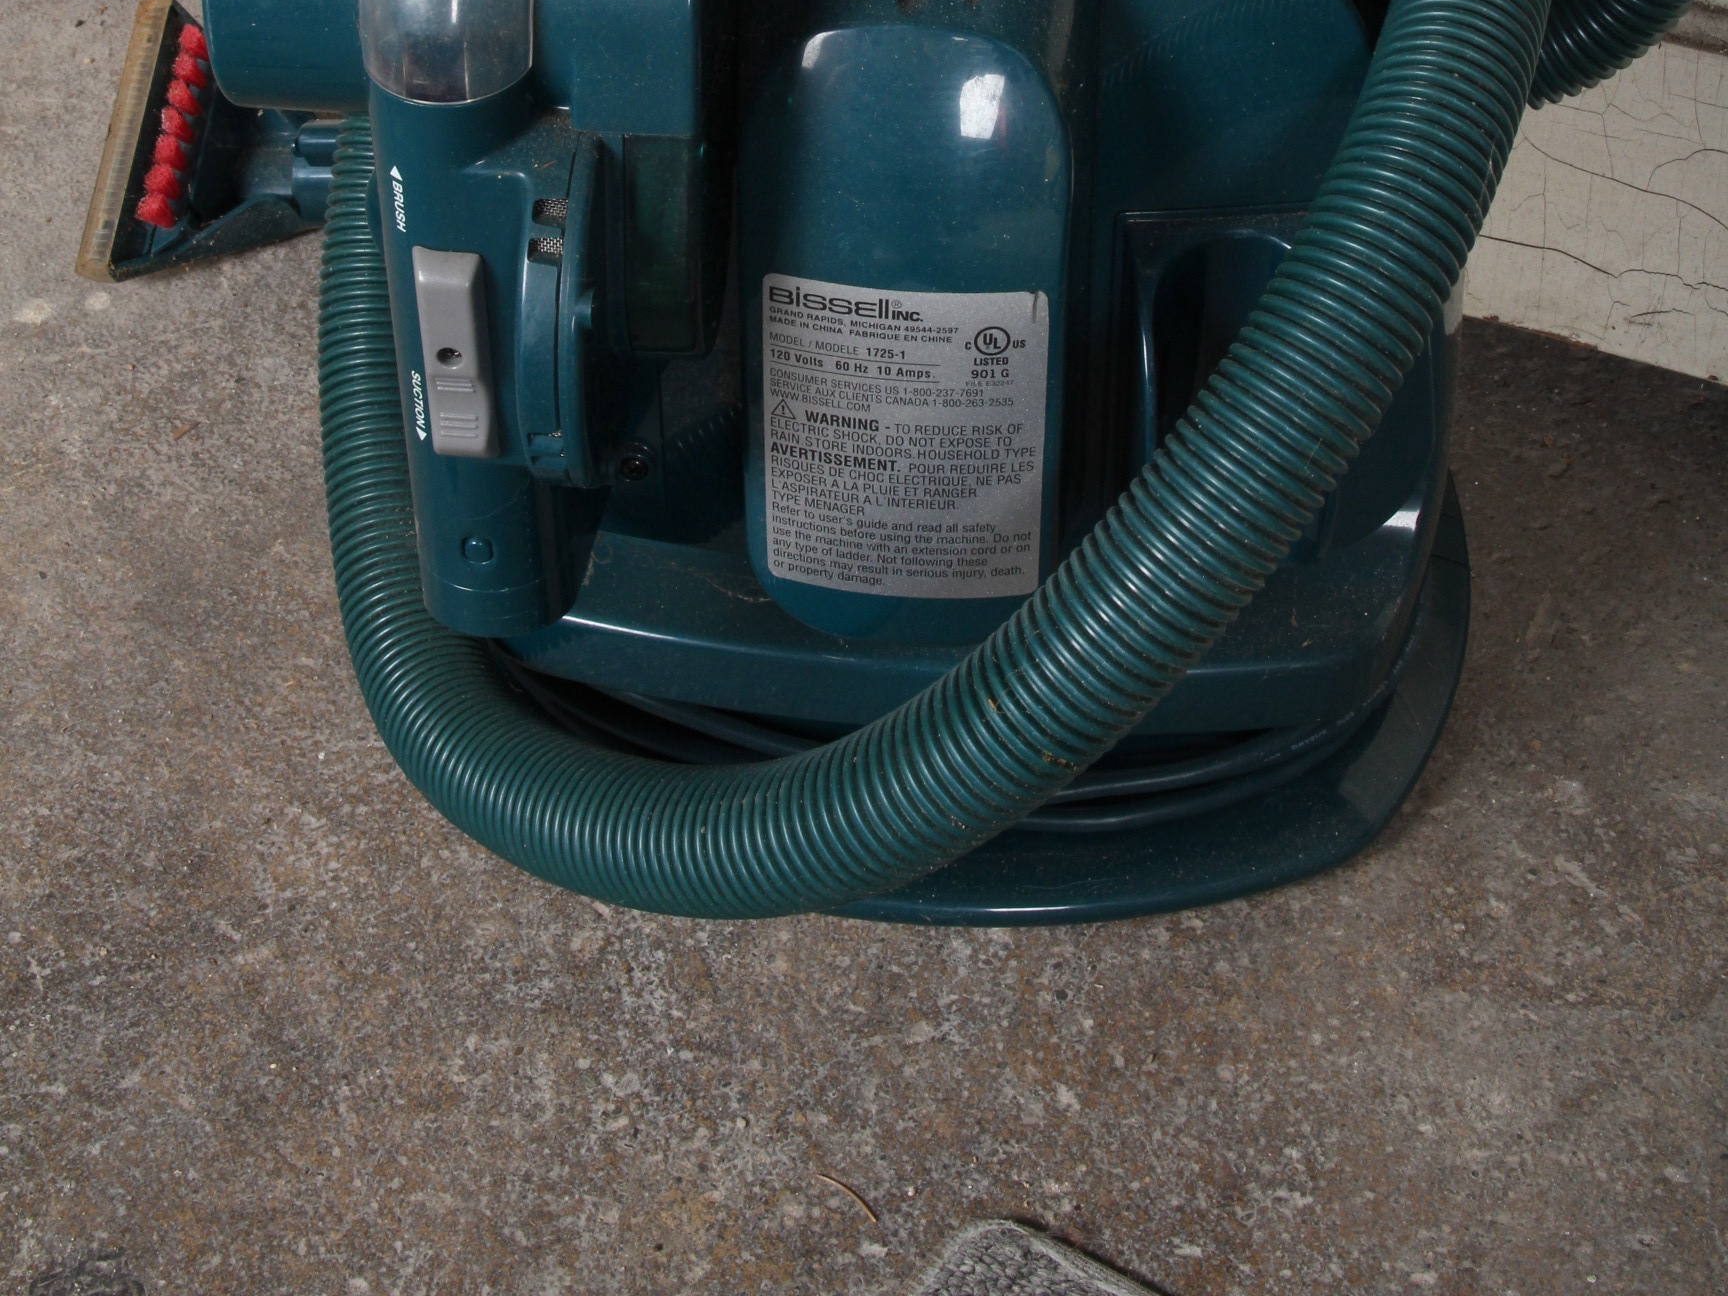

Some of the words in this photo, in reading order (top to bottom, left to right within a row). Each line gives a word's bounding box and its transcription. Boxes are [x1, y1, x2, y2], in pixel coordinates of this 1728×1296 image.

[391, 180, 407, 233] BRUSH
[769, 306, 804, 319] GRAND
[807, 311, 846, 326] RAPIDS,
[851, 320, 900, 332] MICHIGAN
[904, 325, 959, 334] 49544-2597
[769, 315, 796, 327] MADE
[800, 320, 809, 329] IN
[812, 323, 843, 334] CHINA
[849, 329, 900, 341] FABRIQUE
[921, 335, 952, 343] CHINE
[892, 310, 923, 322] INC.
[769, 332, 805, 347] MODEL
[815, 340, 859, 355] MODELE
[866, 347, 905, 360] 1725-1
[983, 333, 1001, 349] UL
[1012, 339, 1026, 348] US
[770, 349, 790, 361] 120
[794, 354, 824, 367] Volts
[835, 361, 849, 371] 60
[854, 363, 868, 374] Hz
[877, 366, 891, 375] 10
[896, 367, 936, 379] Amps.
[971, 369, 996, 379] 901
[1001, 369, 1009, 378] G
[974, 357, 1009, 366] LISTED
[770, 367, 827, 386] CONSUMER
[830, 378, 881, 393] SERVICES
[884, 385, 899, 394] US
[903, 388, 984, 398] 1-800-237-7691
[770, 377, 812, 393] SERVICE
[816, 387, 836, 398] AUX
[839, 390, 882, 404] CLIENTS
[885, 396, 929, 407] CANADA
[932, 398, 1014, 408] 1-800-263-2535
[410, 369, 426, 430] SUCTION
[770, 416, 829, 437] ELECTRIC
[886, 435, 904, 446] DO
[909, 436, 935, 447] NOT
[940, 437, 990, 448] EXPOSE
[995, 436, 1012, 447] TO
[804, 409, 879, 432] WARNING
[894, 423, 910, 434] TO
[914, 425, 967, 436] REDUCE
[972, 424, 1003, 435] RISK
[1007, 423, 1023, 435] OF
[770, 441, 901, 472] AVERTISSEMENT.
[909, 463, 945, 474] POUR
[950, 463, 1007, 475] REDUIRE
[1011, 460, 1034, 472] LES
[805, 436, 847, 453] STORE
[917, 449, 1000, 460] HOUSEHOLD
[1004, 446, 1036, 458] TYPE
[771, 455, 825, 475] RISQUES
[829, 466, 845, 478] DE
[850, 469, 884, 483] CHOC
[976, 475, 992, 486] NE
[997, 474, 1021, 485] PAS
[771, 466, 827, 487] EXPOSER
[831, 479, 840, 489] A
[843, 481, 859, 492] LA
[863, 483, 900, 496] PLUIE
[904, 486, 919, 497] ET
[923, 487, 977, 498] RANGER
[771, 478, 859, 504] L'ASPIRATEUR
[863, 495, 871, 505] A
[772, 489, 801, 505] TYPE
[804, 497, 865, 516] MENAGER
[772, 501, 801, 516] Refer
[804, 509, 815, 520] to
[820, 513, 853, 525] user's
[857, 518, 888, 530] guide
[891, 522, 912, 532] and
[917, 523, 941, 533] read
[945, 523, 958, 533] all
[962, 523, 996, 534] safety
[772, 512, 837, 534] instructions
[840, 527, 876, 541] before
[879, 533, 910, 544] using
[915, 534, 933, 544] the
[993, 533, 1009, 543] Do
[1013, 531, 1031, 542] not
[772, 526, 791, 537] use
[795, 530, 811, 542] the
[815, 535, 863, 549] machine
[867, 541, 891, 552] with
[893, 545, 908, 554] an
[911, 546, 967, 555] extension
[970, 545, 997, 555] cord
[1000, 545, 1013, 554] or
[1016, 544, 1031, 553] on
[772, 536, 791, 550] any
[795, 541, 818, 554] type
[821, 547, 833, 556] of
[877, 554, 897, 564] Not
[901, 556, 953, 568] following
[957, 557, 988, 567] these
[773, 547, 826, 566] directions
[830, 560, 853, 572] may
[857, 564, 888, 575] result
[892, 566, 902, 576] in
[906, 568, 948, 578] serious
[773, 558, 785, 568] or
[788, 563, 834, 580] property
